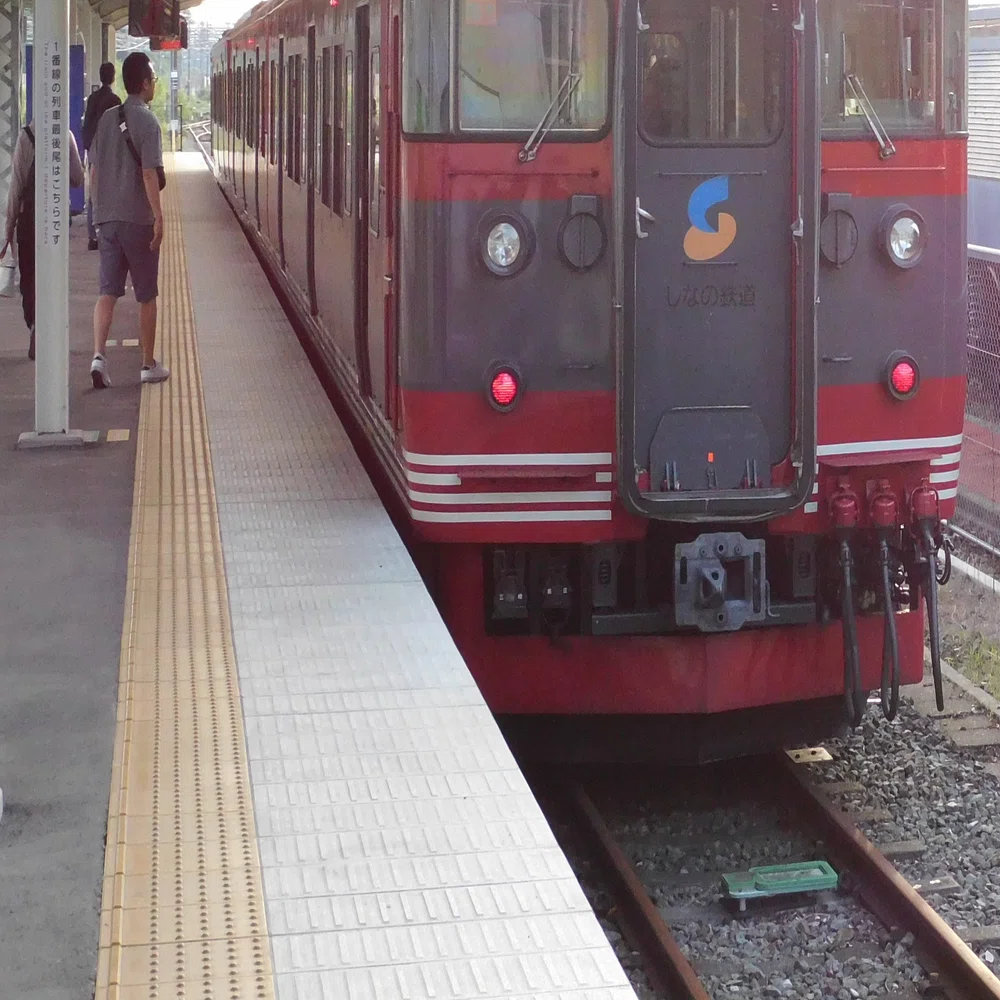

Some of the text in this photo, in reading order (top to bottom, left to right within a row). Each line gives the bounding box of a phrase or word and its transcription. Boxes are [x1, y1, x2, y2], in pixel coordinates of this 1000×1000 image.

[52, 41, 61, 245] 1番線の列車最後尾はこちらです
[666, 285, 756, 307] しなの鉄道
